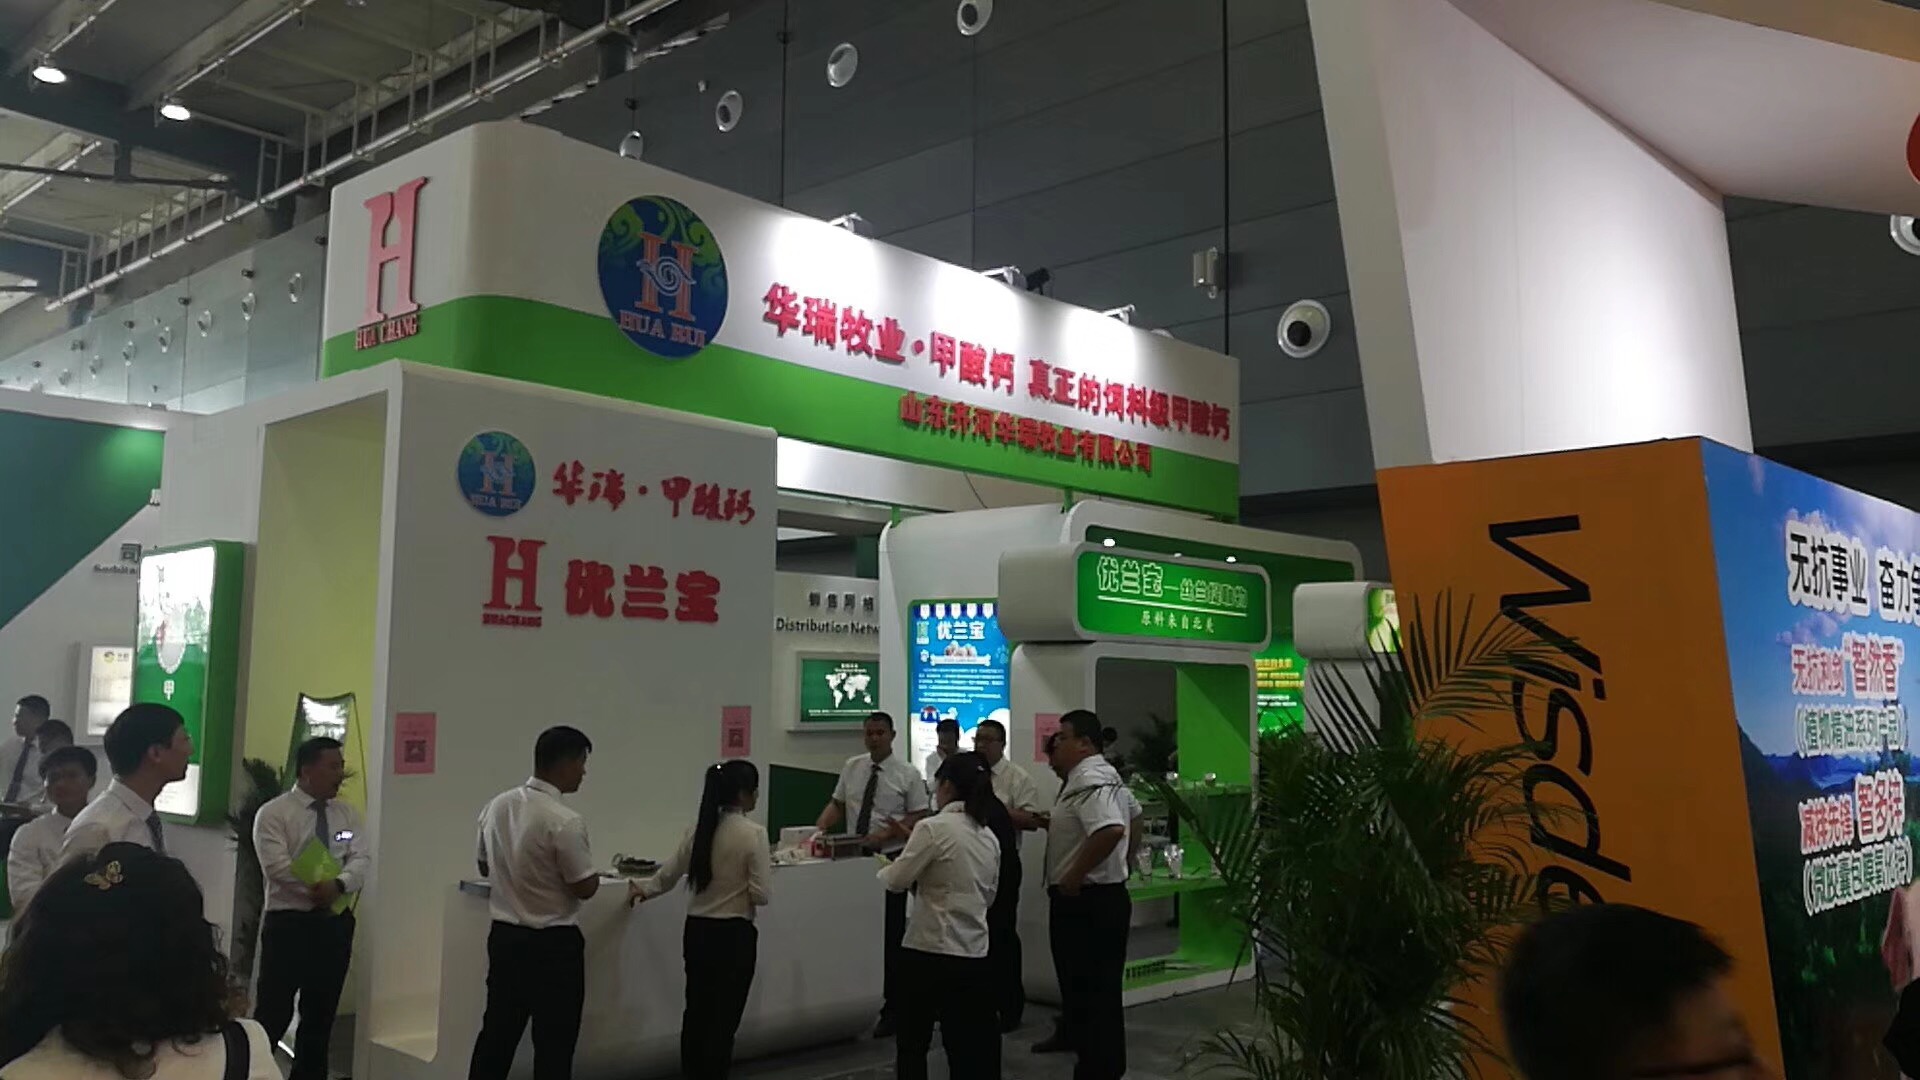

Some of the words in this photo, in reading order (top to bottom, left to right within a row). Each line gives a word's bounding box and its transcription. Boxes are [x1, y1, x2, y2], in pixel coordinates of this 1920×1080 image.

[355, 325, 379, 350] HUA
[380, 314, 419, 344] CHANG
[619, 309, 666, 339] HUA
[1790, 532, 1867, 605] 无抗事业
[565, 559, 720, 623] 优兰宝
[776, 617, 849, 633] Distribution
[937, 620, 985, 640] 优兰宝
